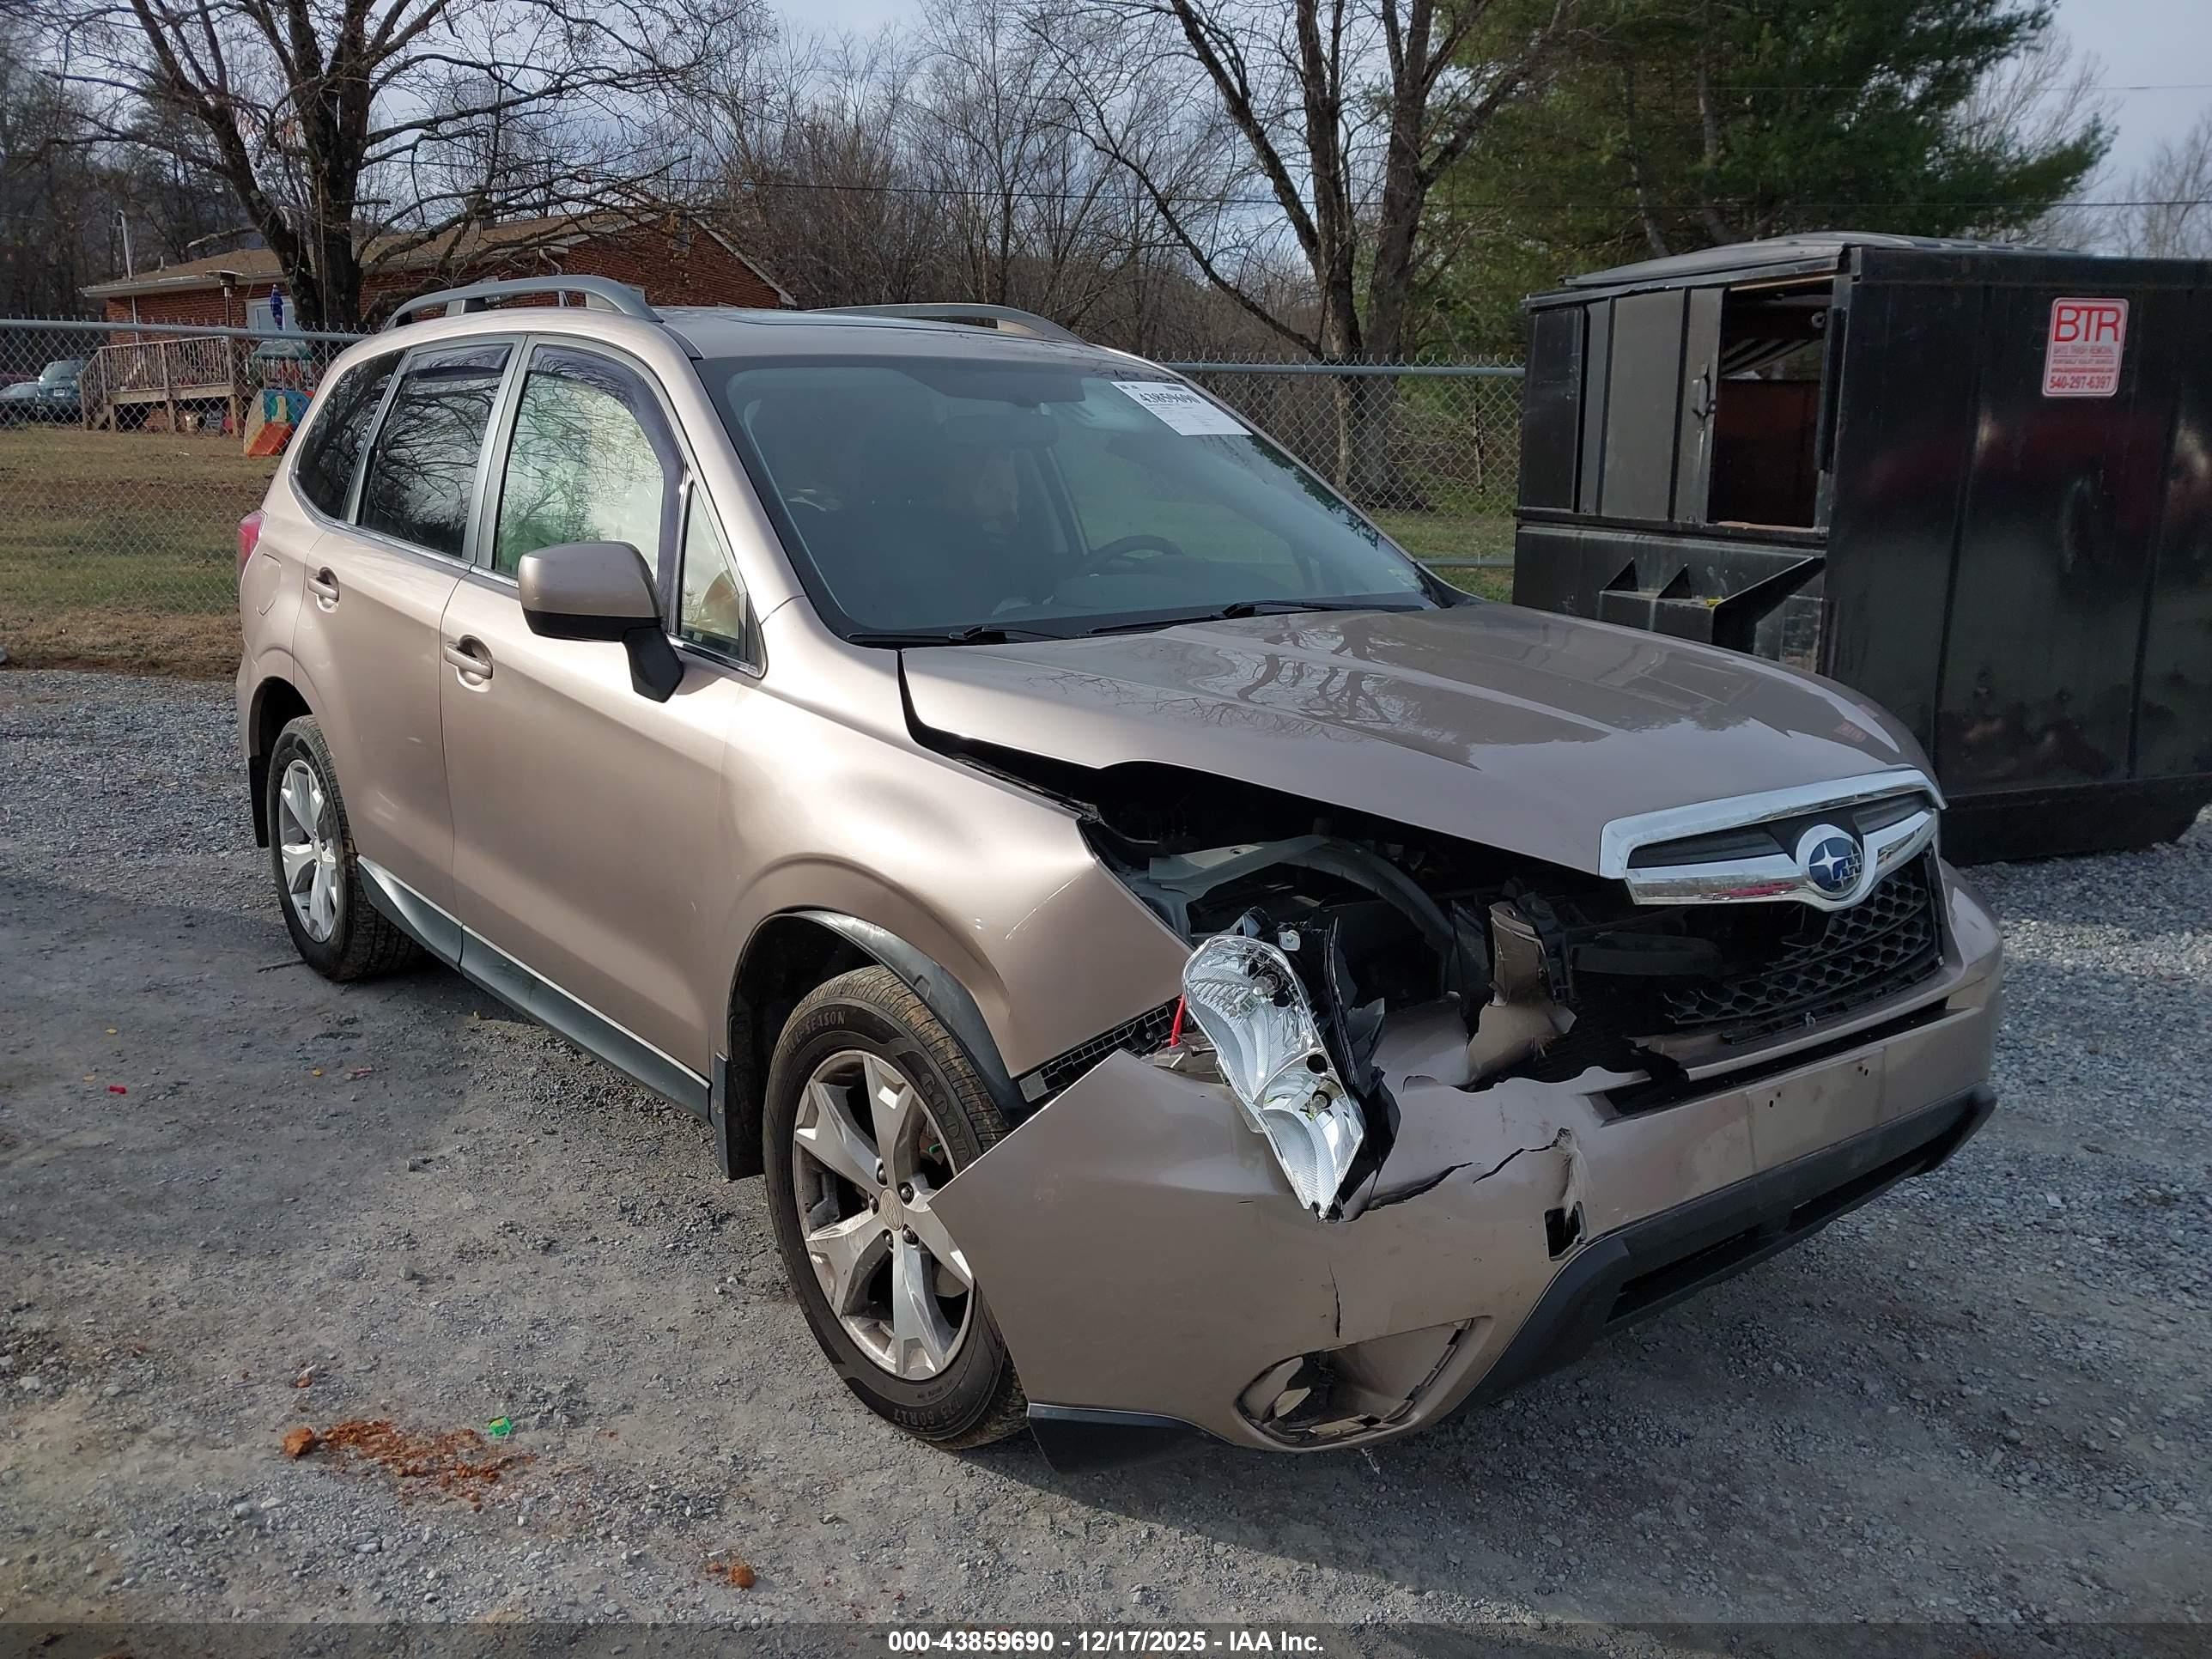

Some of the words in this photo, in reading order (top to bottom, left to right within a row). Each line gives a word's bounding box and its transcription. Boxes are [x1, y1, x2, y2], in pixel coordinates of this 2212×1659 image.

[2053, 305, 2121, 342] BTR
[2049, 375, 2112, 389] 540-297-6397
[1139, 392, 1201, 404] 43859690
